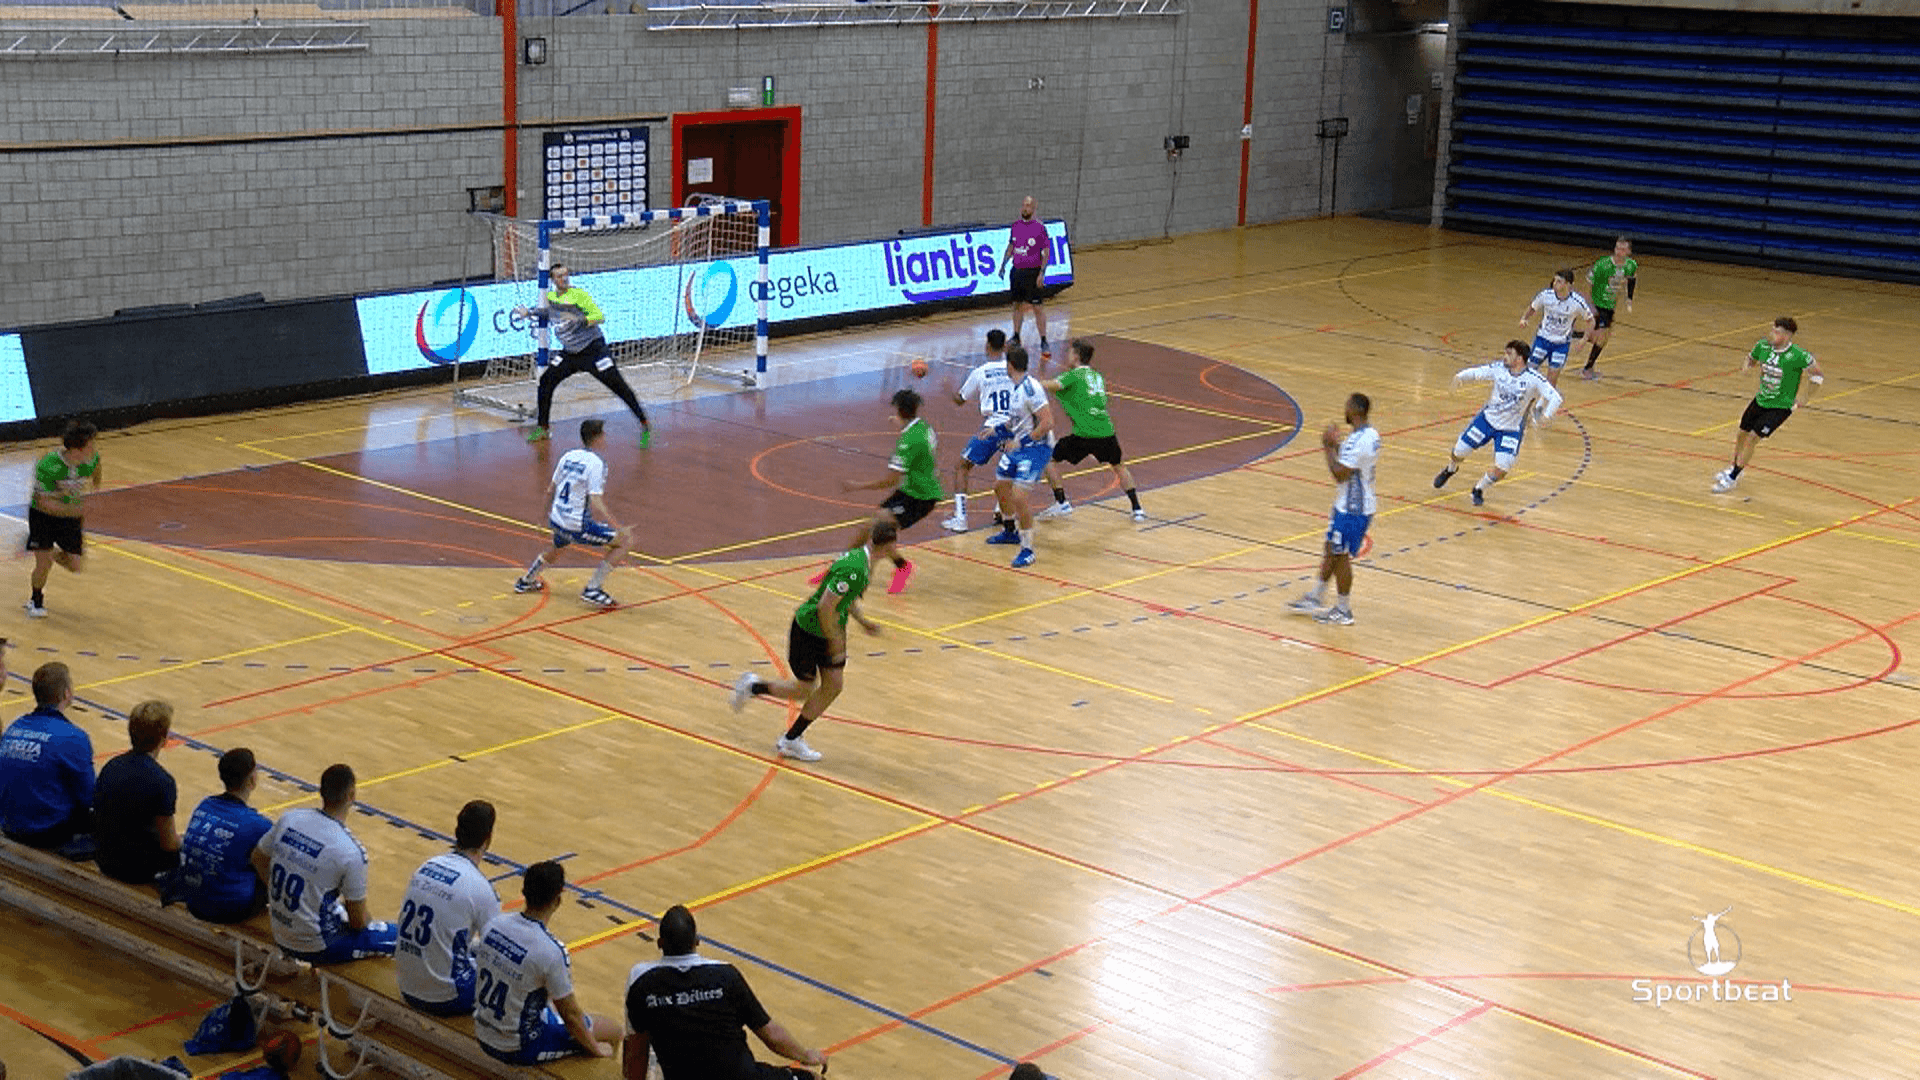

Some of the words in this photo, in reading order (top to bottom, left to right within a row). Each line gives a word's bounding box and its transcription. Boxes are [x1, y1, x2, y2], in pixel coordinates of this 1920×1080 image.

[883, 231, 996, 286] liantis
[988, 389, 1011, 412] 18
[559, 481, 571, 504] 4
[270, 863, 305, 913] 99
[399, 899, 434, 947] 23
[478, 967, 509, 1021] 24
